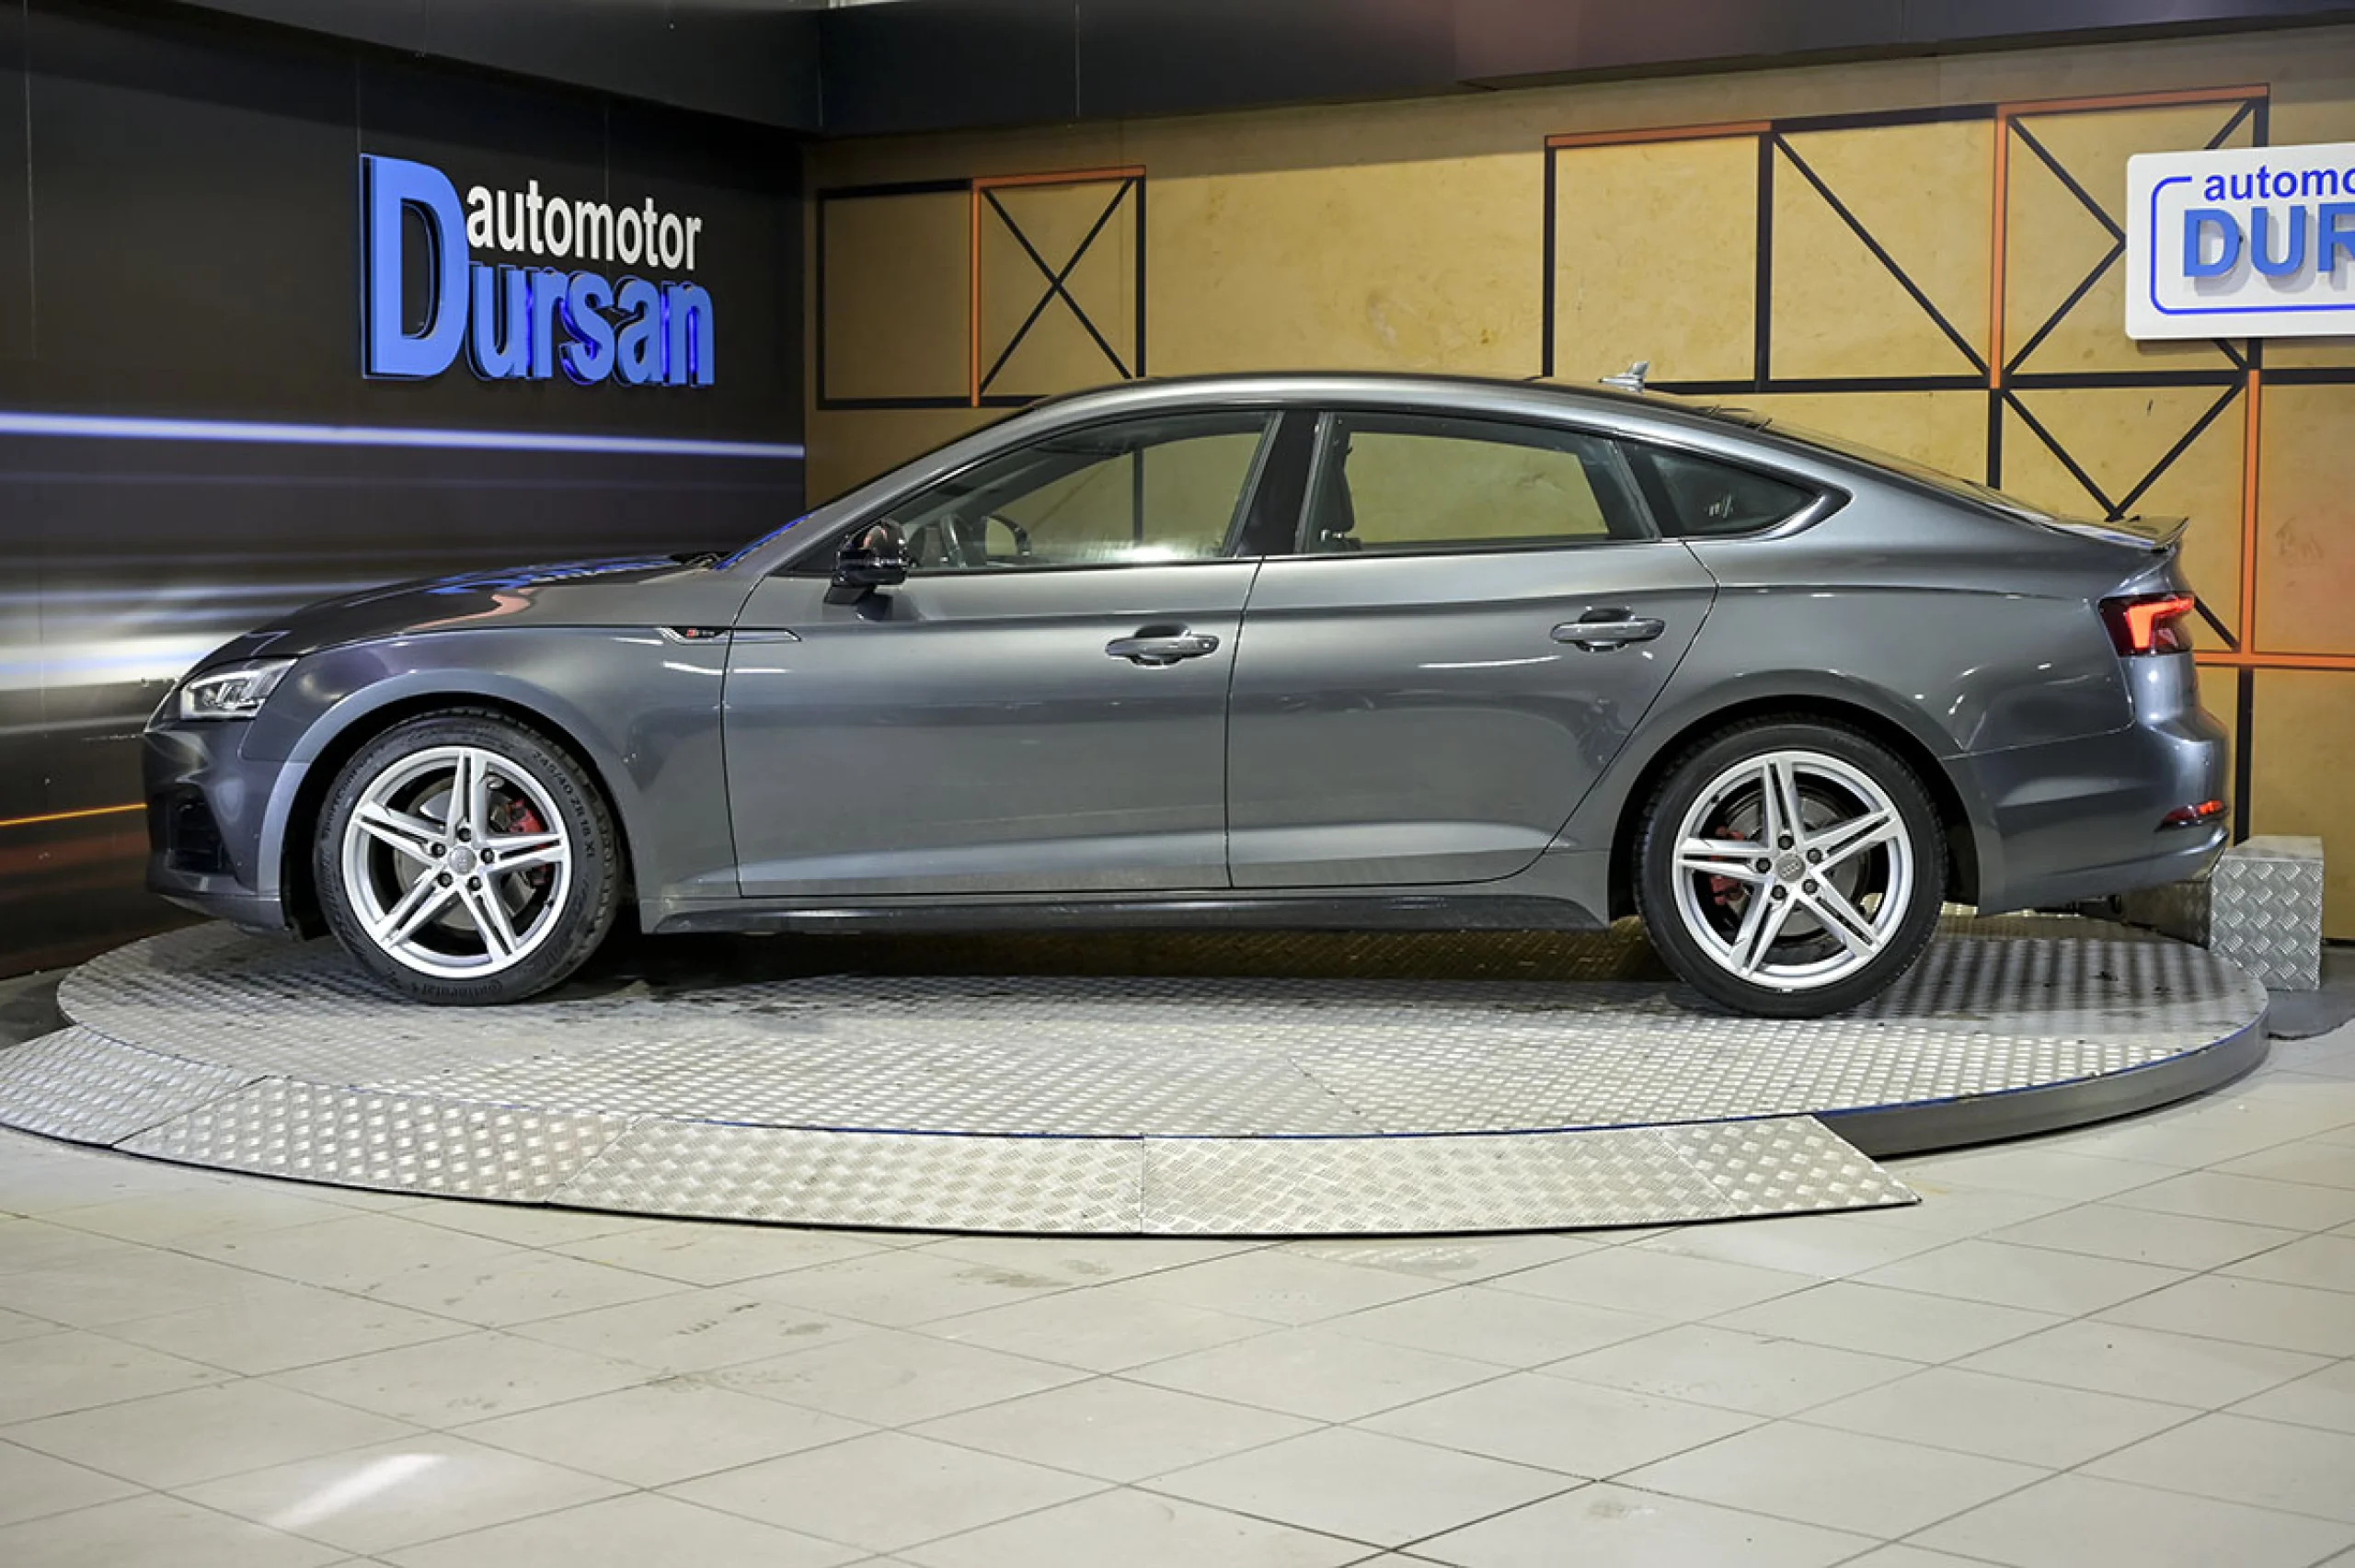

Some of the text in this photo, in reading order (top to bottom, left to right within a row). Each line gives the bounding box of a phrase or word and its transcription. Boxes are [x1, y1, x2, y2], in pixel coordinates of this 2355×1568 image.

[466, 180, 703, 269] automotor
[2183, 202, 2355, 277] DUR
[360, 153, 715, 387] Dursan
